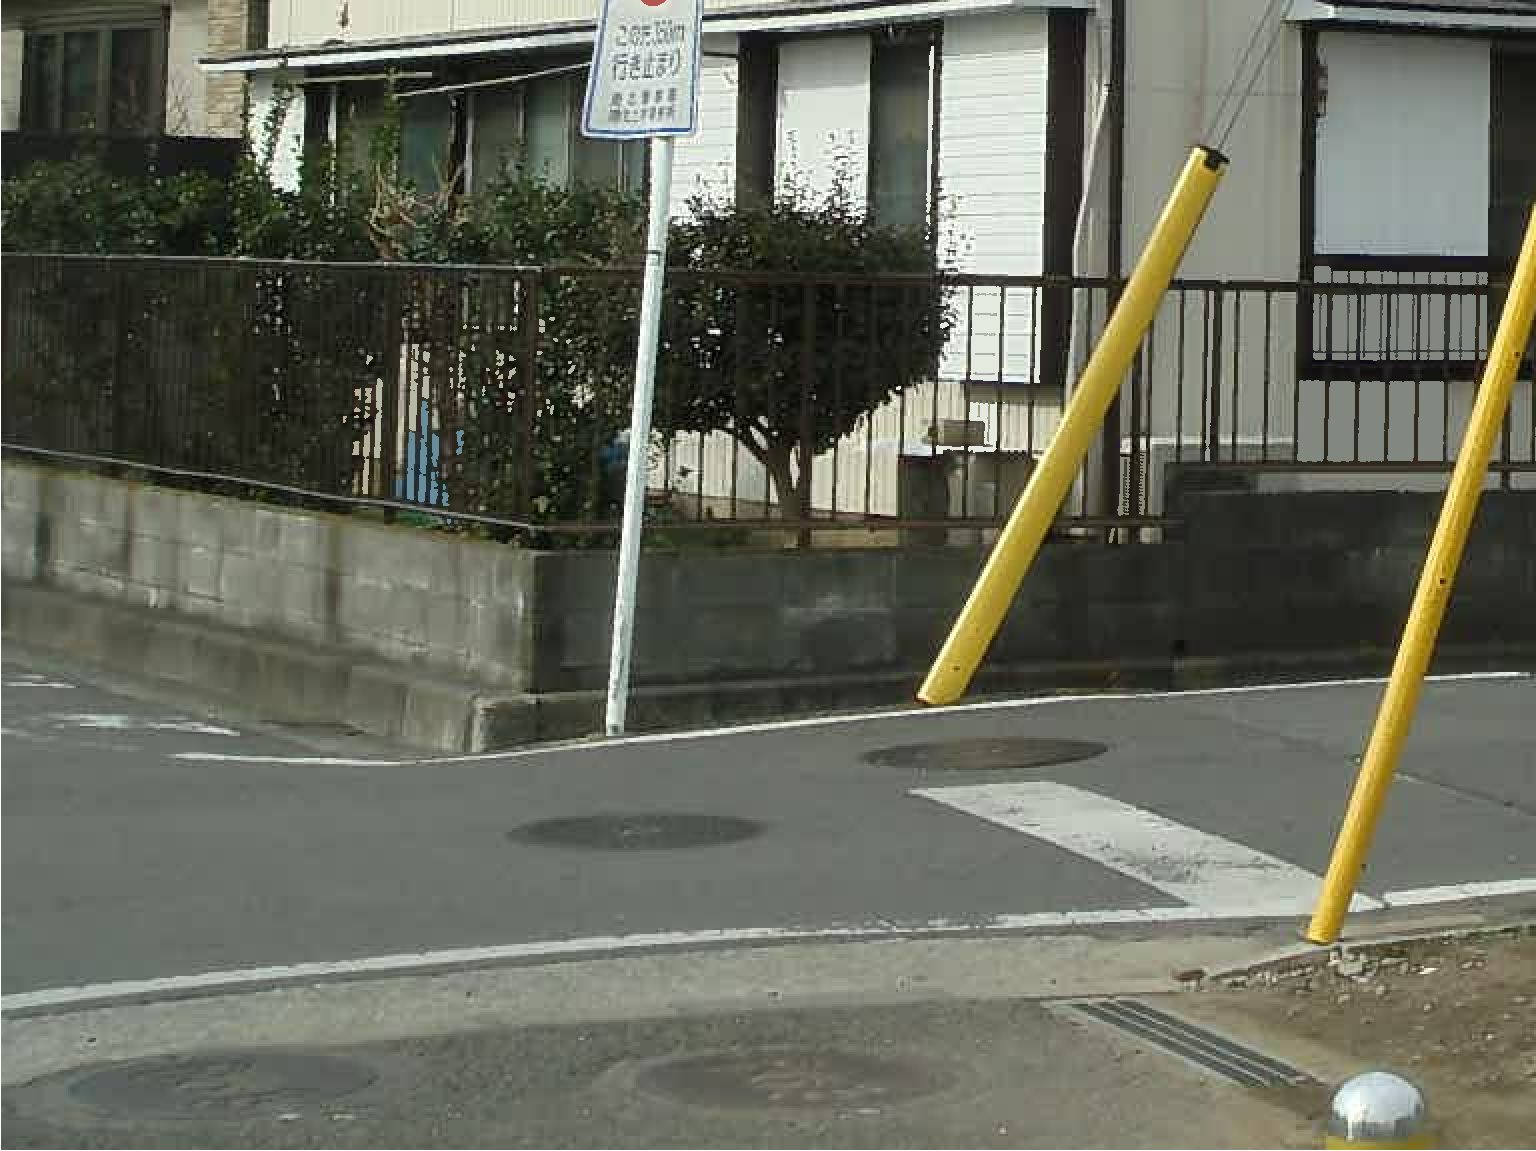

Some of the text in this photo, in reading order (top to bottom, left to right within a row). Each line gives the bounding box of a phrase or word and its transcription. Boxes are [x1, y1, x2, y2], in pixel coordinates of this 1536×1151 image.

[613, 49, 680, 81] 行き止まり
